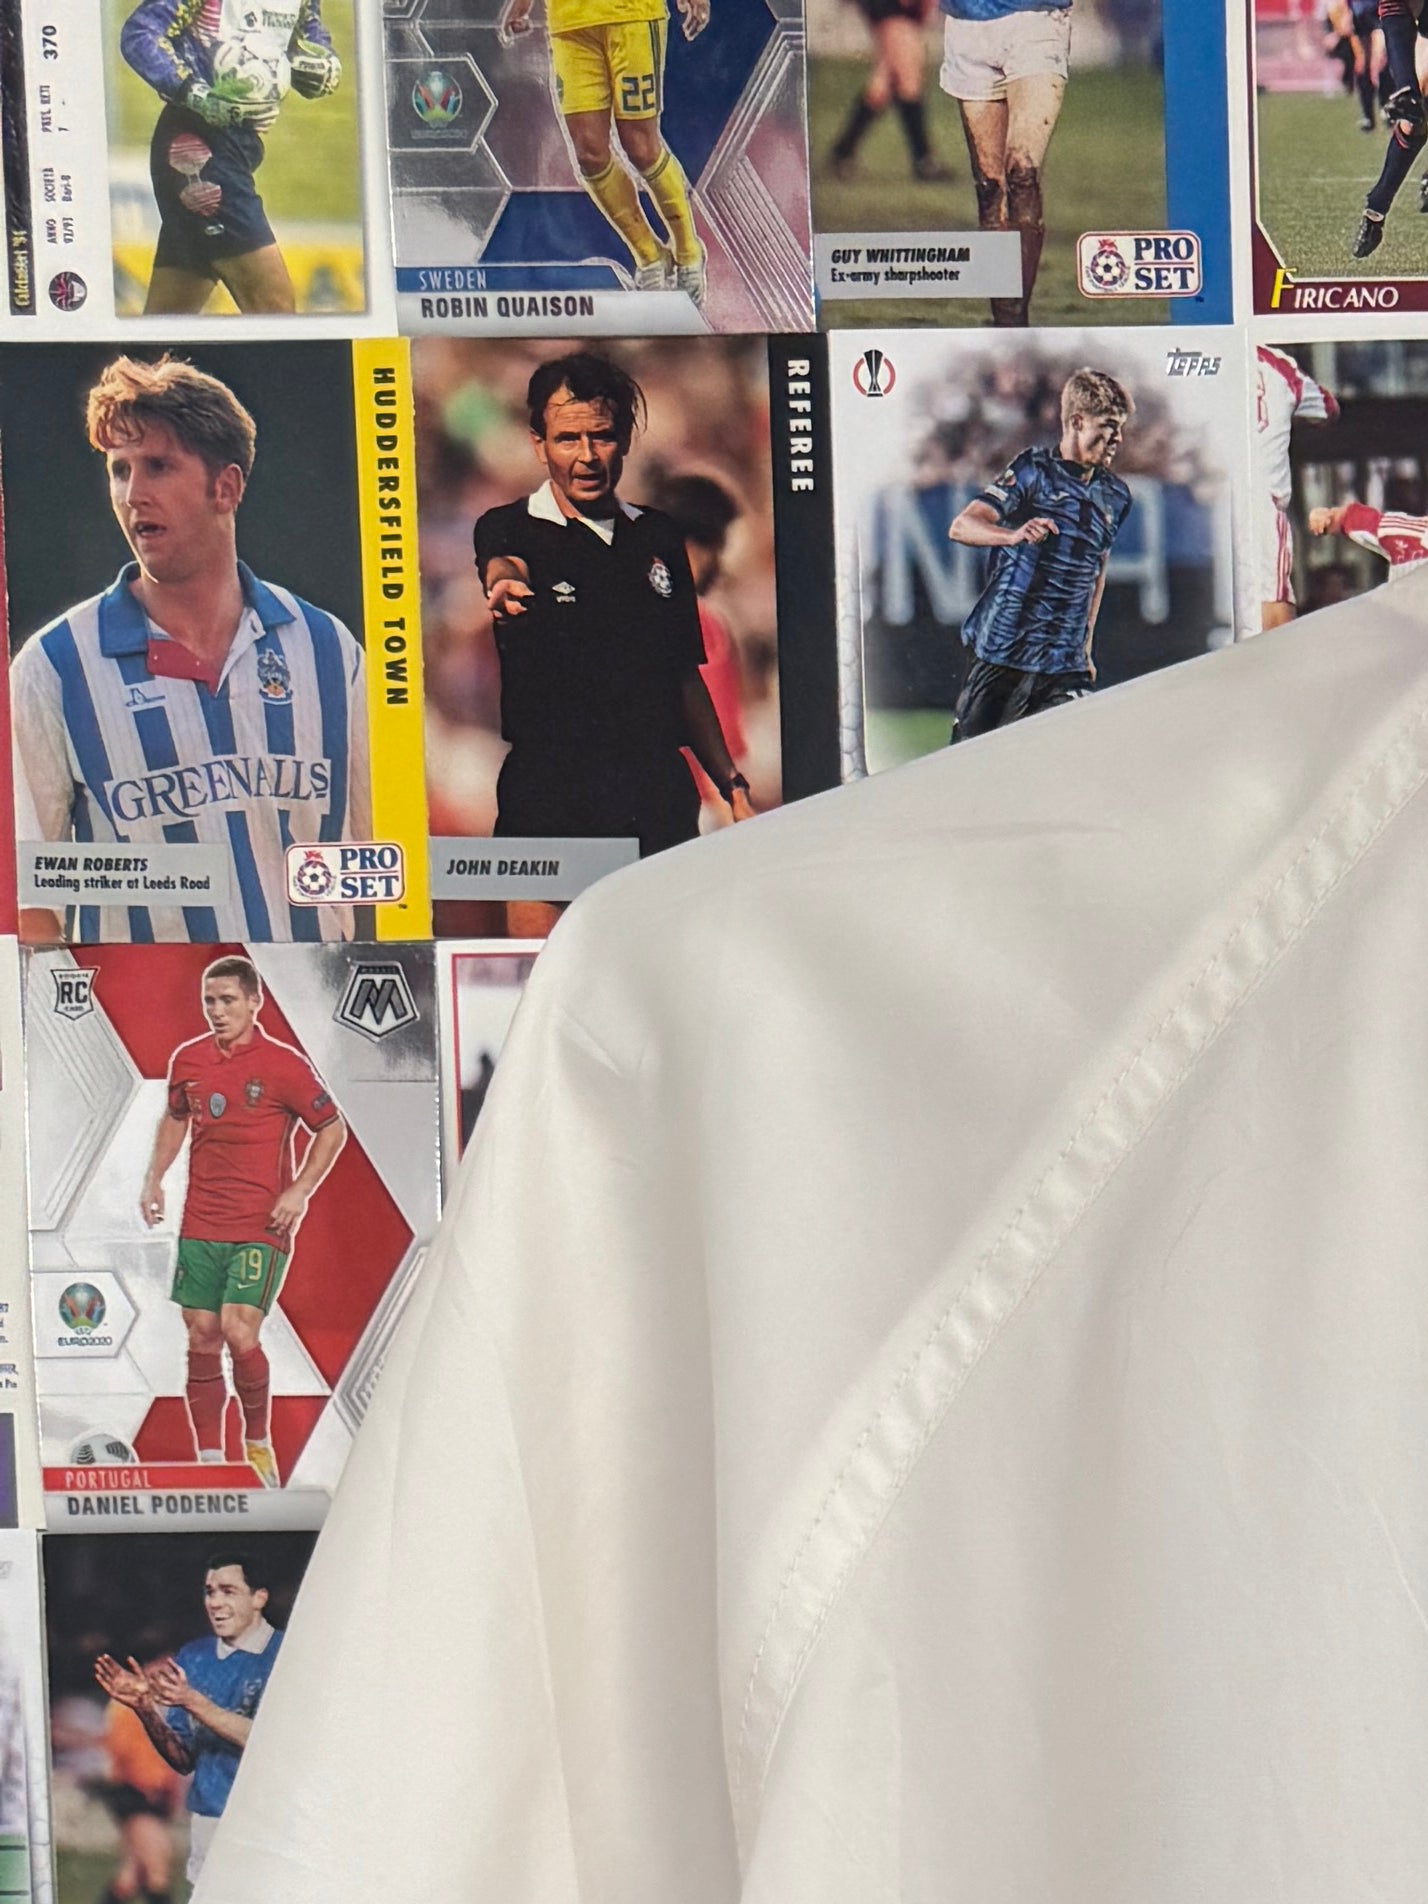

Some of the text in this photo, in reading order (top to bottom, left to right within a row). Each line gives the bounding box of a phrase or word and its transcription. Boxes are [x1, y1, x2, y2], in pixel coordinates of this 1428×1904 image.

[43, 25, 57, 60] 370
[621, 74, 655, 112] 22
[831, 248, 970, 264] GUY WHITTINGHAM
[1134, 238, 1193, 261] PRO
[419, 271, 487, 290] SWEDEN
[831, 267, 960, 285] Ex-army sharpshooter
[1134, 268, 1194, 290] SET
[1270, 268, 1400, 309] FIRICANO
[421, 296, 594, 318] ROBIN QUAISON
[788, 359, 814, 492] REFEREE
[373, 367, 408, 705] HUDDERSFIELD TOWN
[111, 757, 329, 822] GREENALLS
[35, 856, 148, 872] EWAN ROBERTS
[340, 848, 399, 870] PRO
[447, 860, 559, 876] JOHN DEAKIN
[34, 874, 210, 892] Leading striker at Leeds Road
[341, 876, 399, 899] SET
[60, 981, 88, 1003] RC
[237, 1249, 263, 1283] 19
[65, 1469, 152, 1488] PORTUGAL
[67, 1494, 249, 1516] DANIEL PODENCE
